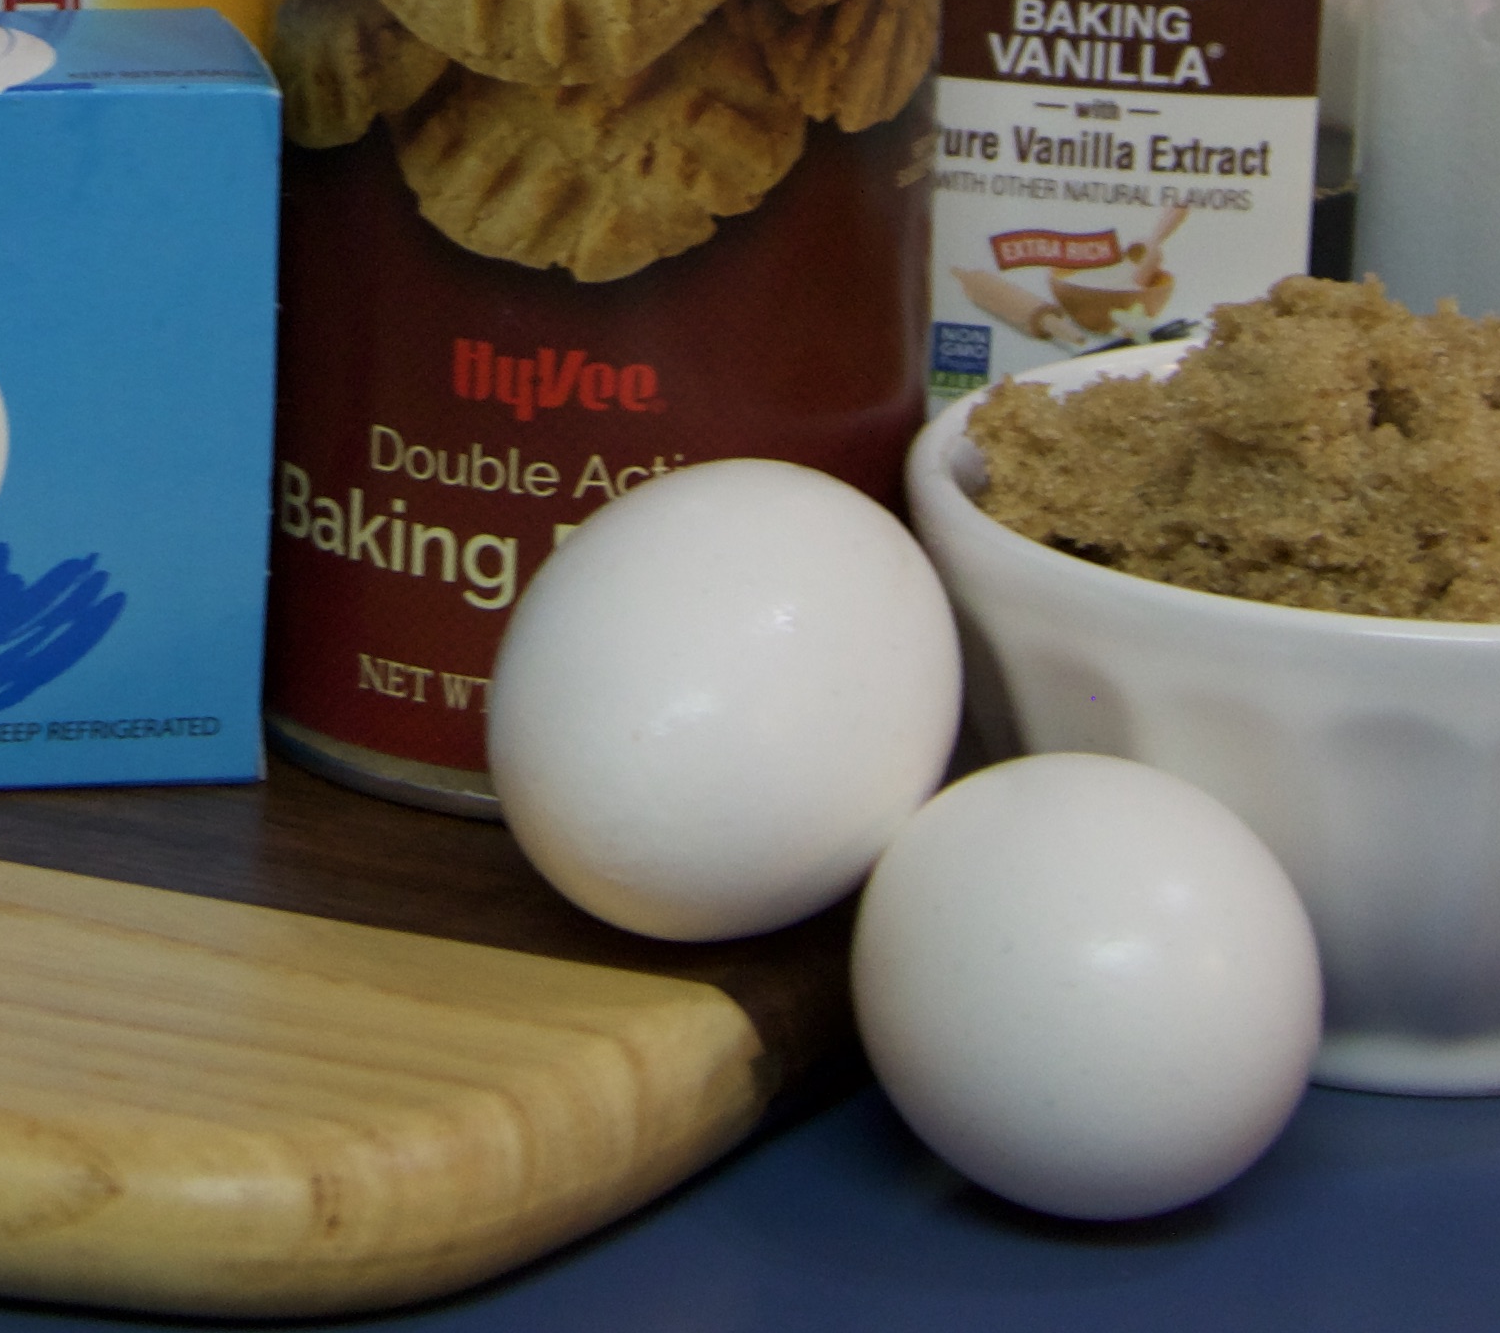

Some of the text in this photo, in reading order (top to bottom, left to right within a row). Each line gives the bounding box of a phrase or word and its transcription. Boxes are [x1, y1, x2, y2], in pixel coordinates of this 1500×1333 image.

[938, 125, 1271, 179] ure Vanilla Extract
[991, 175, 1057, 201] OTHER
[1063, 180, 1155, 207] NATURAL
[1160, 185, 1254, 213] FLAVORS
[369, 423, 561, 497] Double
[279, 459, 519, 610] Baking
[356, 652, 433, 704] NET
[46, 716, 222, 741] REFRIGERATED
